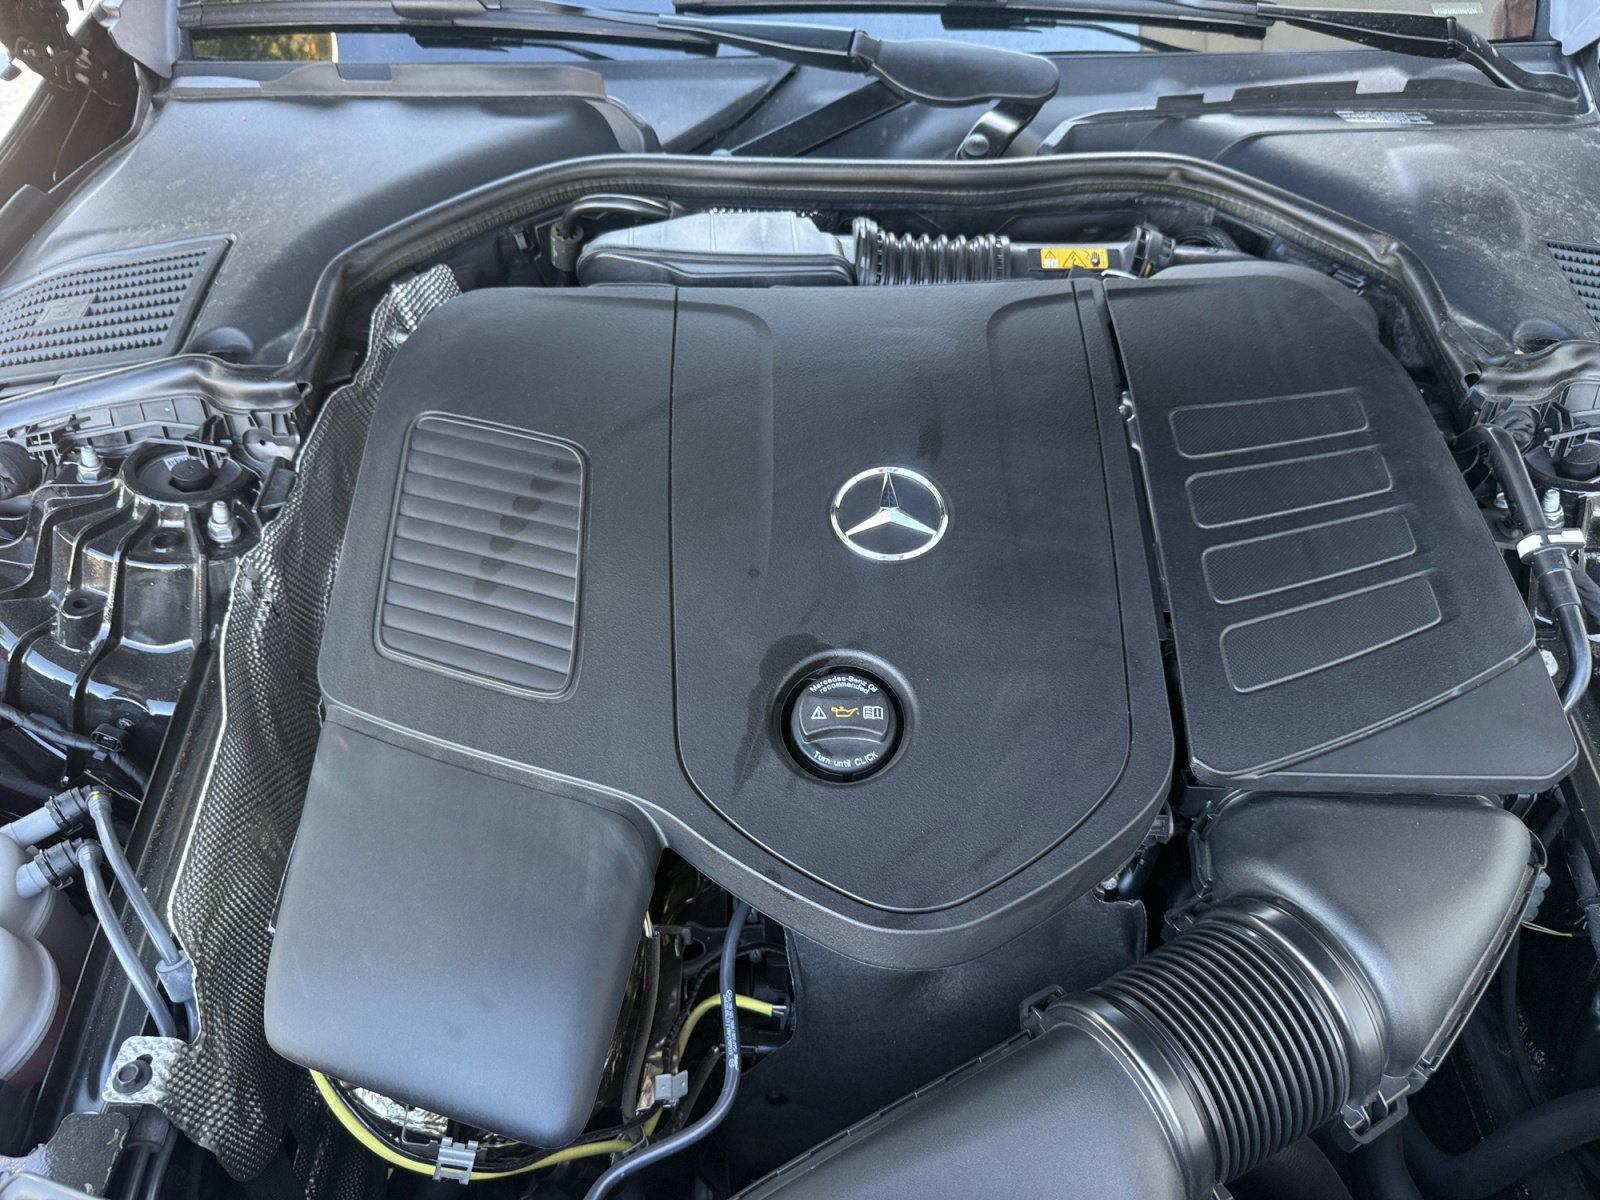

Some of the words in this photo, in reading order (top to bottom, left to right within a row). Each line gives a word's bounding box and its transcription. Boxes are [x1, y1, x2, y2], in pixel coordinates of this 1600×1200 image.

[809, 675, 867, 693] Mercedes-Benz
[868, 683, 878, 693] Oil
[819, 681, 870, 694] recommended
[814, 750, 831, 764] Turn
[854, 750, 878, 766] CLICK
